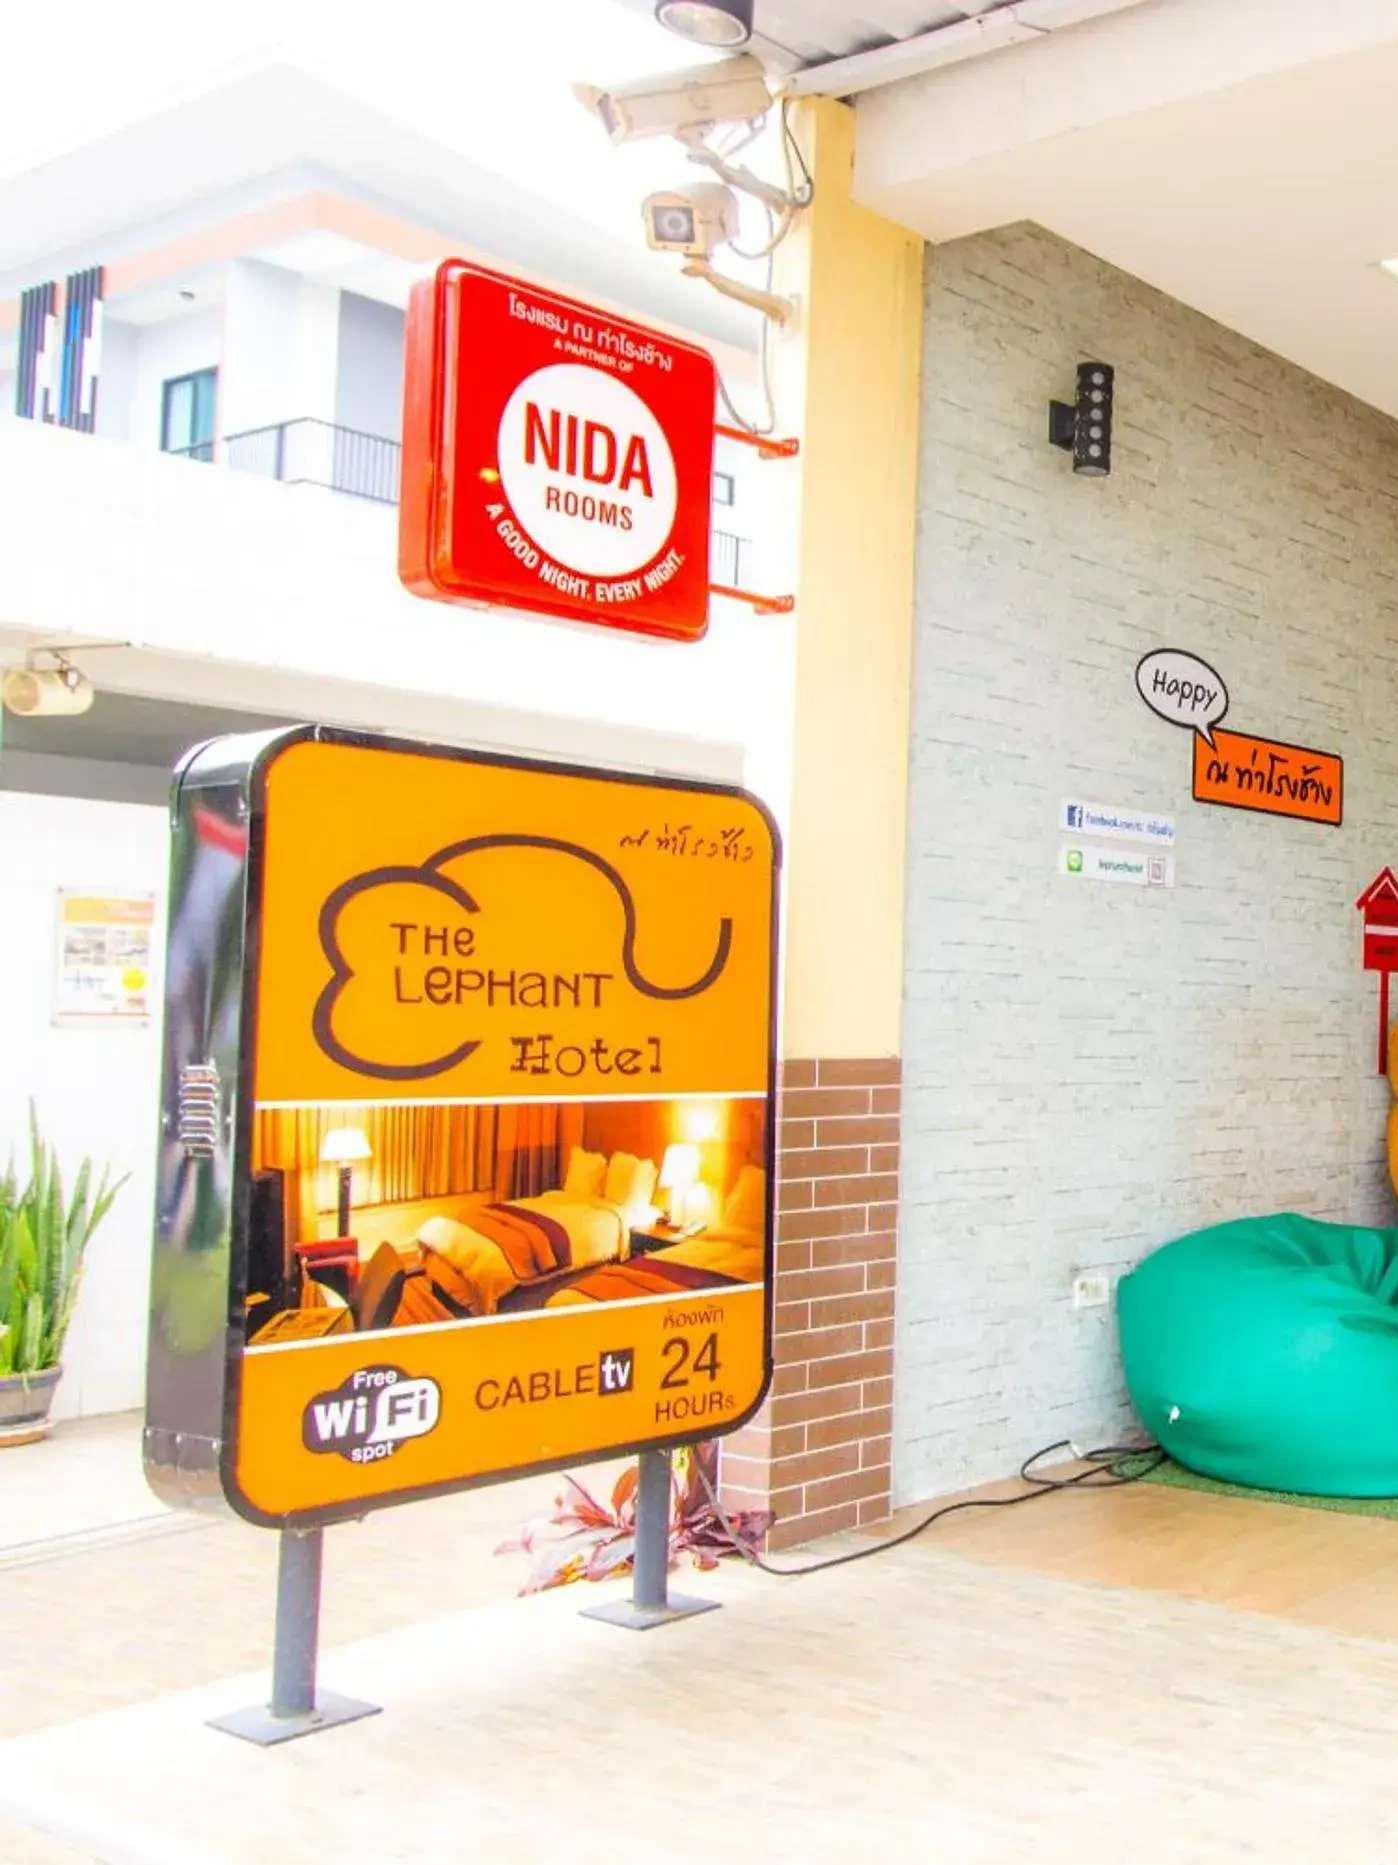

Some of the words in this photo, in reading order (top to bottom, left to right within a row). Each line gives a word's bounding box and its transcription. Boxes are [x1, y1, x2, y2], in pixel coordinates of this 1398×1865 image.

[508, 292, 568, 334] โรงแรม
[573, 322, 593, 343] ณ
[597, 327, 673, 372] ท่าโรงช้าง
[553, 337, 563, 350] A
[563, 340, 617, 368] PARTNER
[618, 360, 634, 373] OF
[524, 401, 653, 498] NIDA
[546, 485, 633, 532] ROOMS
[485, 502, 505, 521] A
[496, 518, 540, 570] GOOD
[538, 560, 592, 602] NIGHT.
[595, 578, 642, 603] EVERY
[643, 547, 686, 593] NIGHT.
[1152, 667, 1218, 712] Happy
[1206, 759, 1229, 784] ณ
[1235, 748, 1333, 806] ท่าโรงช้าง
[509, 1034, 662, 1077] Hotel
[352, 1369, 398, 1390] Free
[475, 1364, 594, 1411] CABLE
[601, 1354, 631, 1390] tv
[659, 1331, 722, 1390] 24
[351, 1440, 395, 1463] spot
